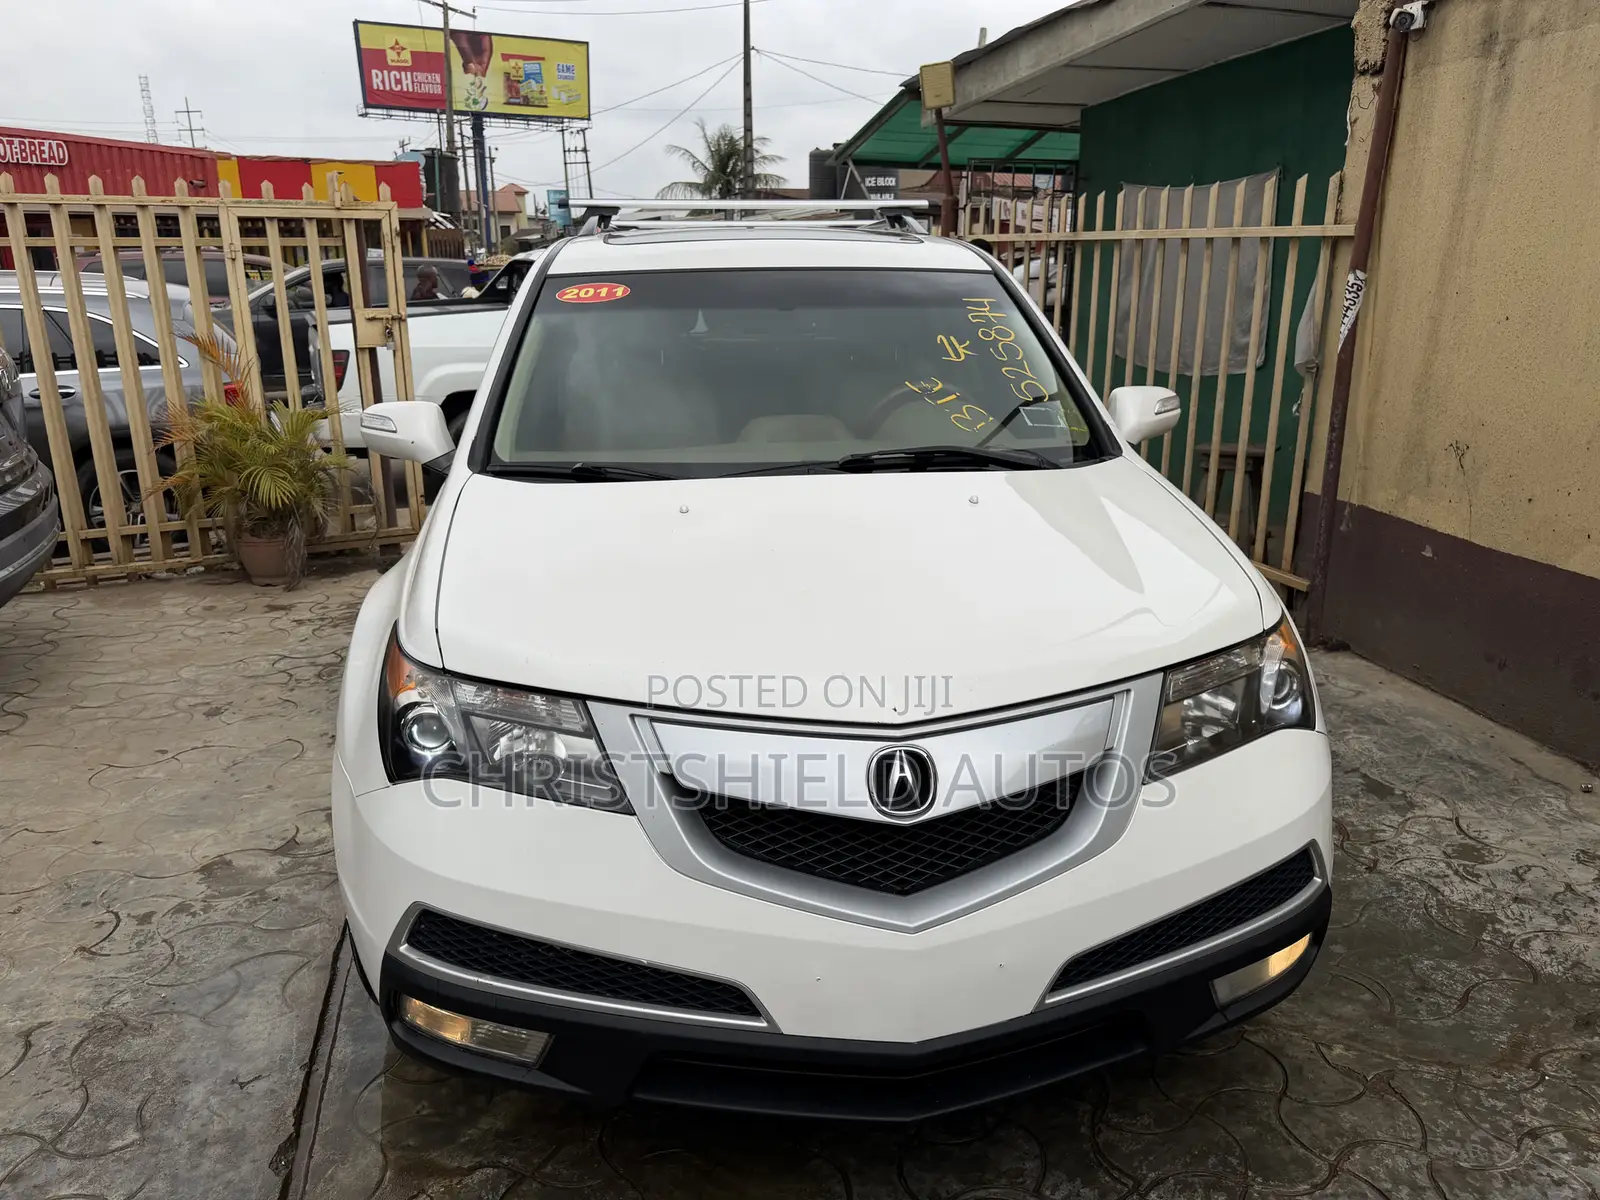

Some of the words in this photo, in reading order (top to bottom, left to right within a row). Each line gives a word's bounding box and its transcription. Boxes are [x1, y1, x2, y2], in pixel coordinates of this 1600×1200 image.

[557, 63, 576, 75] GAME
[371, 69, 413, 92] RICH
[413, 72, 441, 83] CHICKEN
[413, 83, 442, 94] FLAVOUR
[865, 176, 877, 187] ICE
[877, 176, 896, 187] BLOCK
[562, 286, 625, 299] 2011
